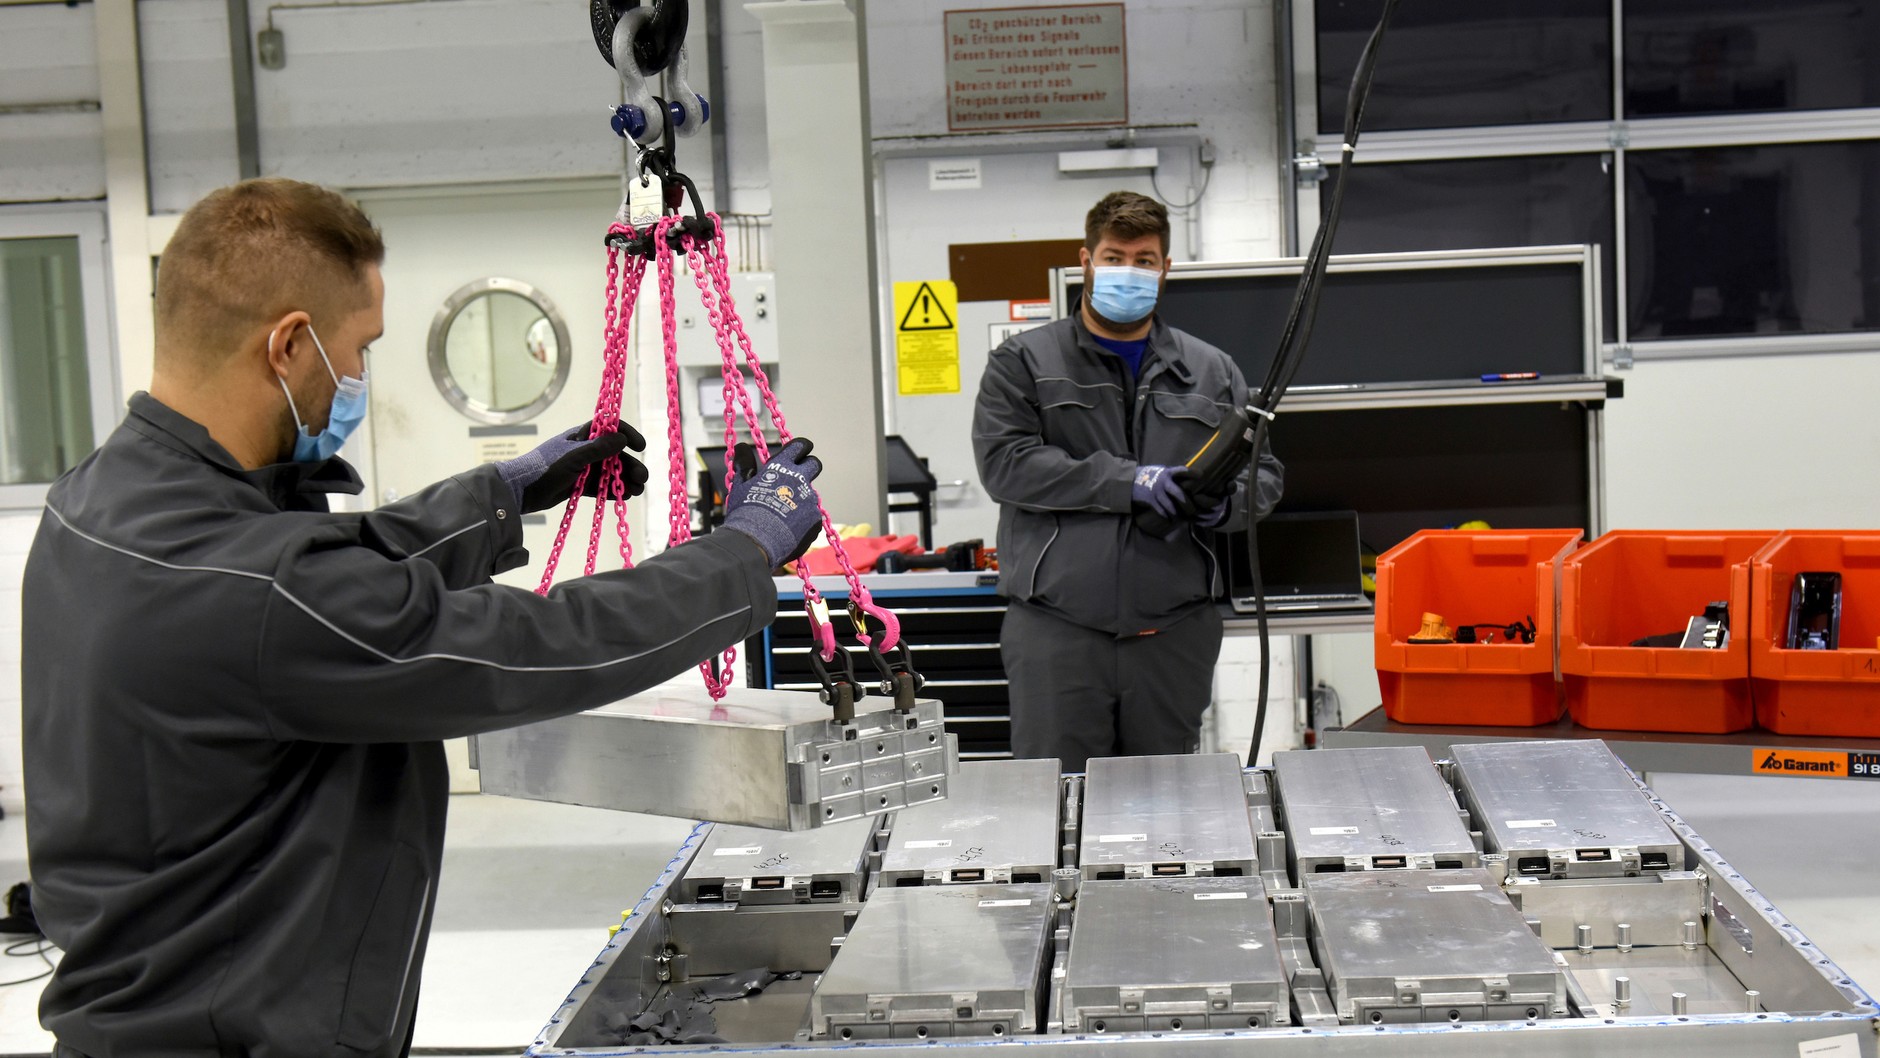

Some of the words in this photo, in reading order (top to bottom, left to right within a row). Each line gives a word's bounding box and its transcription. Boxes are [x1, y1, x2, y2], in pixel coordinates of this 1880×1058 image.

[993, 16, 1057, 31] geschützter
[1061, 14, 1102, 26] Bereich
[953, 34, 968, 46] Bei
[972, 33, 1013, 45] Ertönen
[1017, 32, 1035, 43] des
[1041, 31, 1080, 44] Signals
[953, 50, 985, 61] diesen
[988, 48, 1029, 60] Bereich
[1032, 46, 1063, 57] sofort
[1068, 44, 1120, 56] verlassen
[1001, 61, 1072, 75] Lebensgefahr
[954, 80, 993, 92] Bereich
[996, 79, 1016, 90] darf
[1021, 78, 1044, 89] erst
[1047, 76, 1073, 88] nach
[954, 95, 999, 108] Freigabe
[1002, 94, 1030, 105] durch
[1033, 92, 1049, 104] die
[1053, 90, 1107, 102] Feuerwehr
[955, 110, 1000, 122] betreten
[1004, 109, 1041, 120] werden
[1853, 763, 1868, 774] 91
